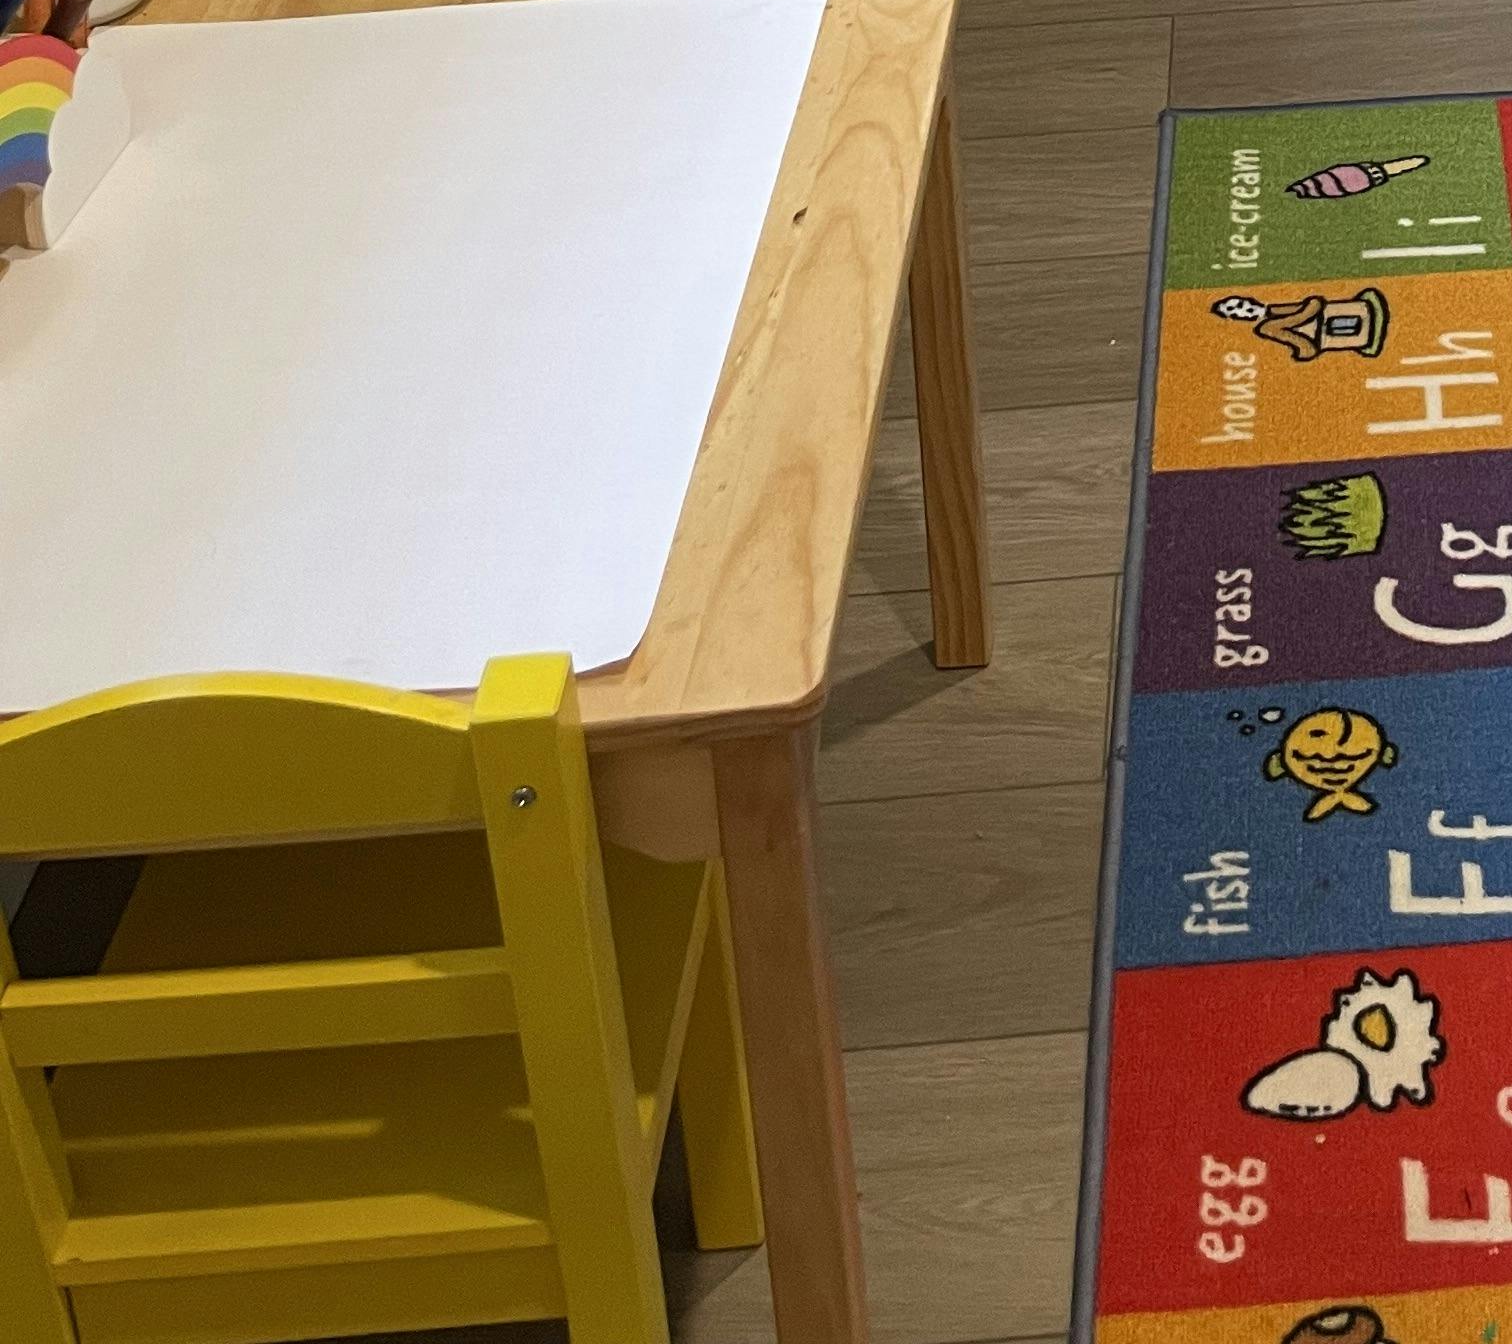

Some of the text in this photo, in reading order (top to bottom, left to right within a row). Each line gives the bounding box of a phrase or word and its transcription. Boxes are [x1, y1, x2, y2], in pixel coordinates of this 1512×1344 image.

[1210, 147, 1261, 272] ice-cream
[1362, 214, 1487, 260] Ii
[1201, 350, 1257, 445] house
[1365, 330, 1503, 437] Hh
[1214, 566, 1270, 669] grass
[1183, 848, 1250, 937] fish
[1198, 1152, 1268, 1265] egg
